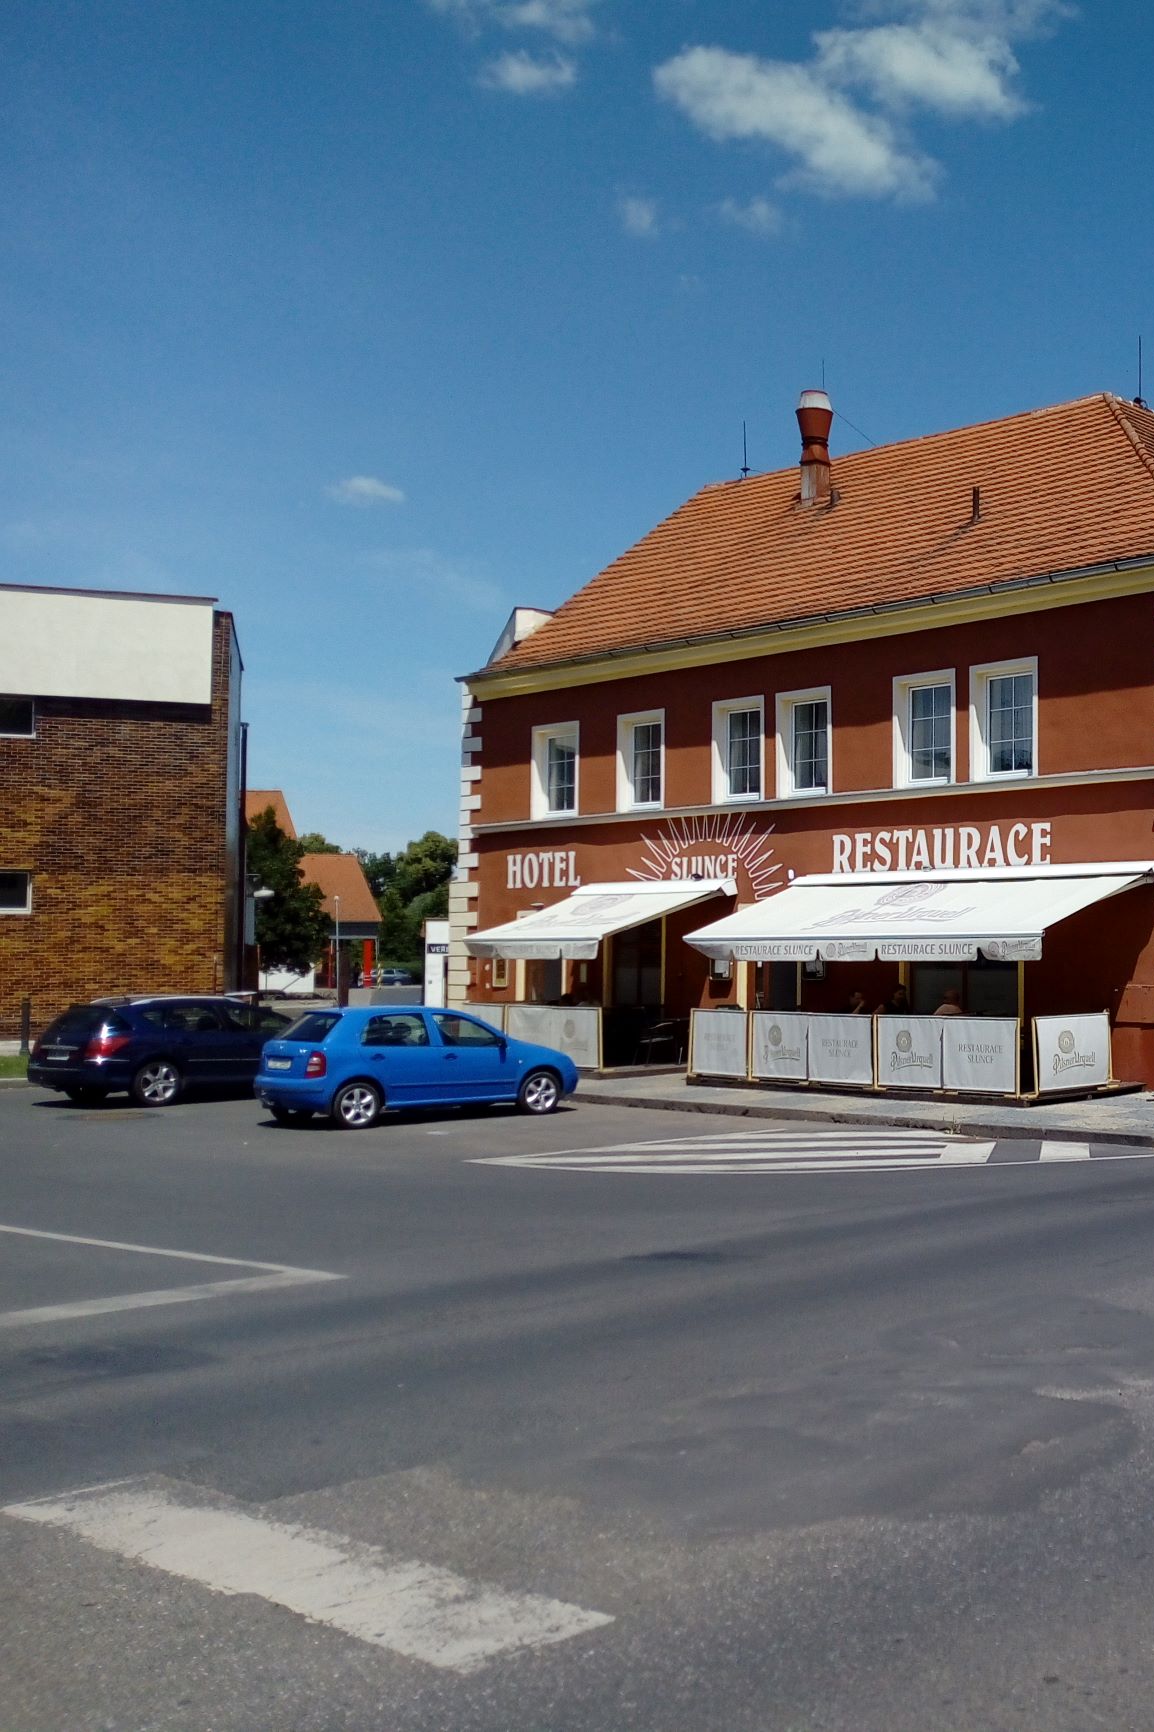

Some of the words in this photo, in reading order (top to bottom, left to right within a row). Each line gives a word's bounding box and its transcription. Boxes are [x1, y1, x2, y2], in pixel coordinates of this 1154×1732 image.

[832, 822, 1051, 873] RESTAURACE
[506, 851, 581, 889] HOTEL
[670, 854, 737, 880] SLUNCE
[735, 945, 782, 956] RESTAURACE
[783, 945, 814, 955] SLUNCE
[881, 944, 937, 955] RESTAURACE
[938, 944, 973, 955] SLUNCE
[958, 1043, 1003, 1054] RESTAURACE
[967, 1054, 994, 1064] SLUNCE
